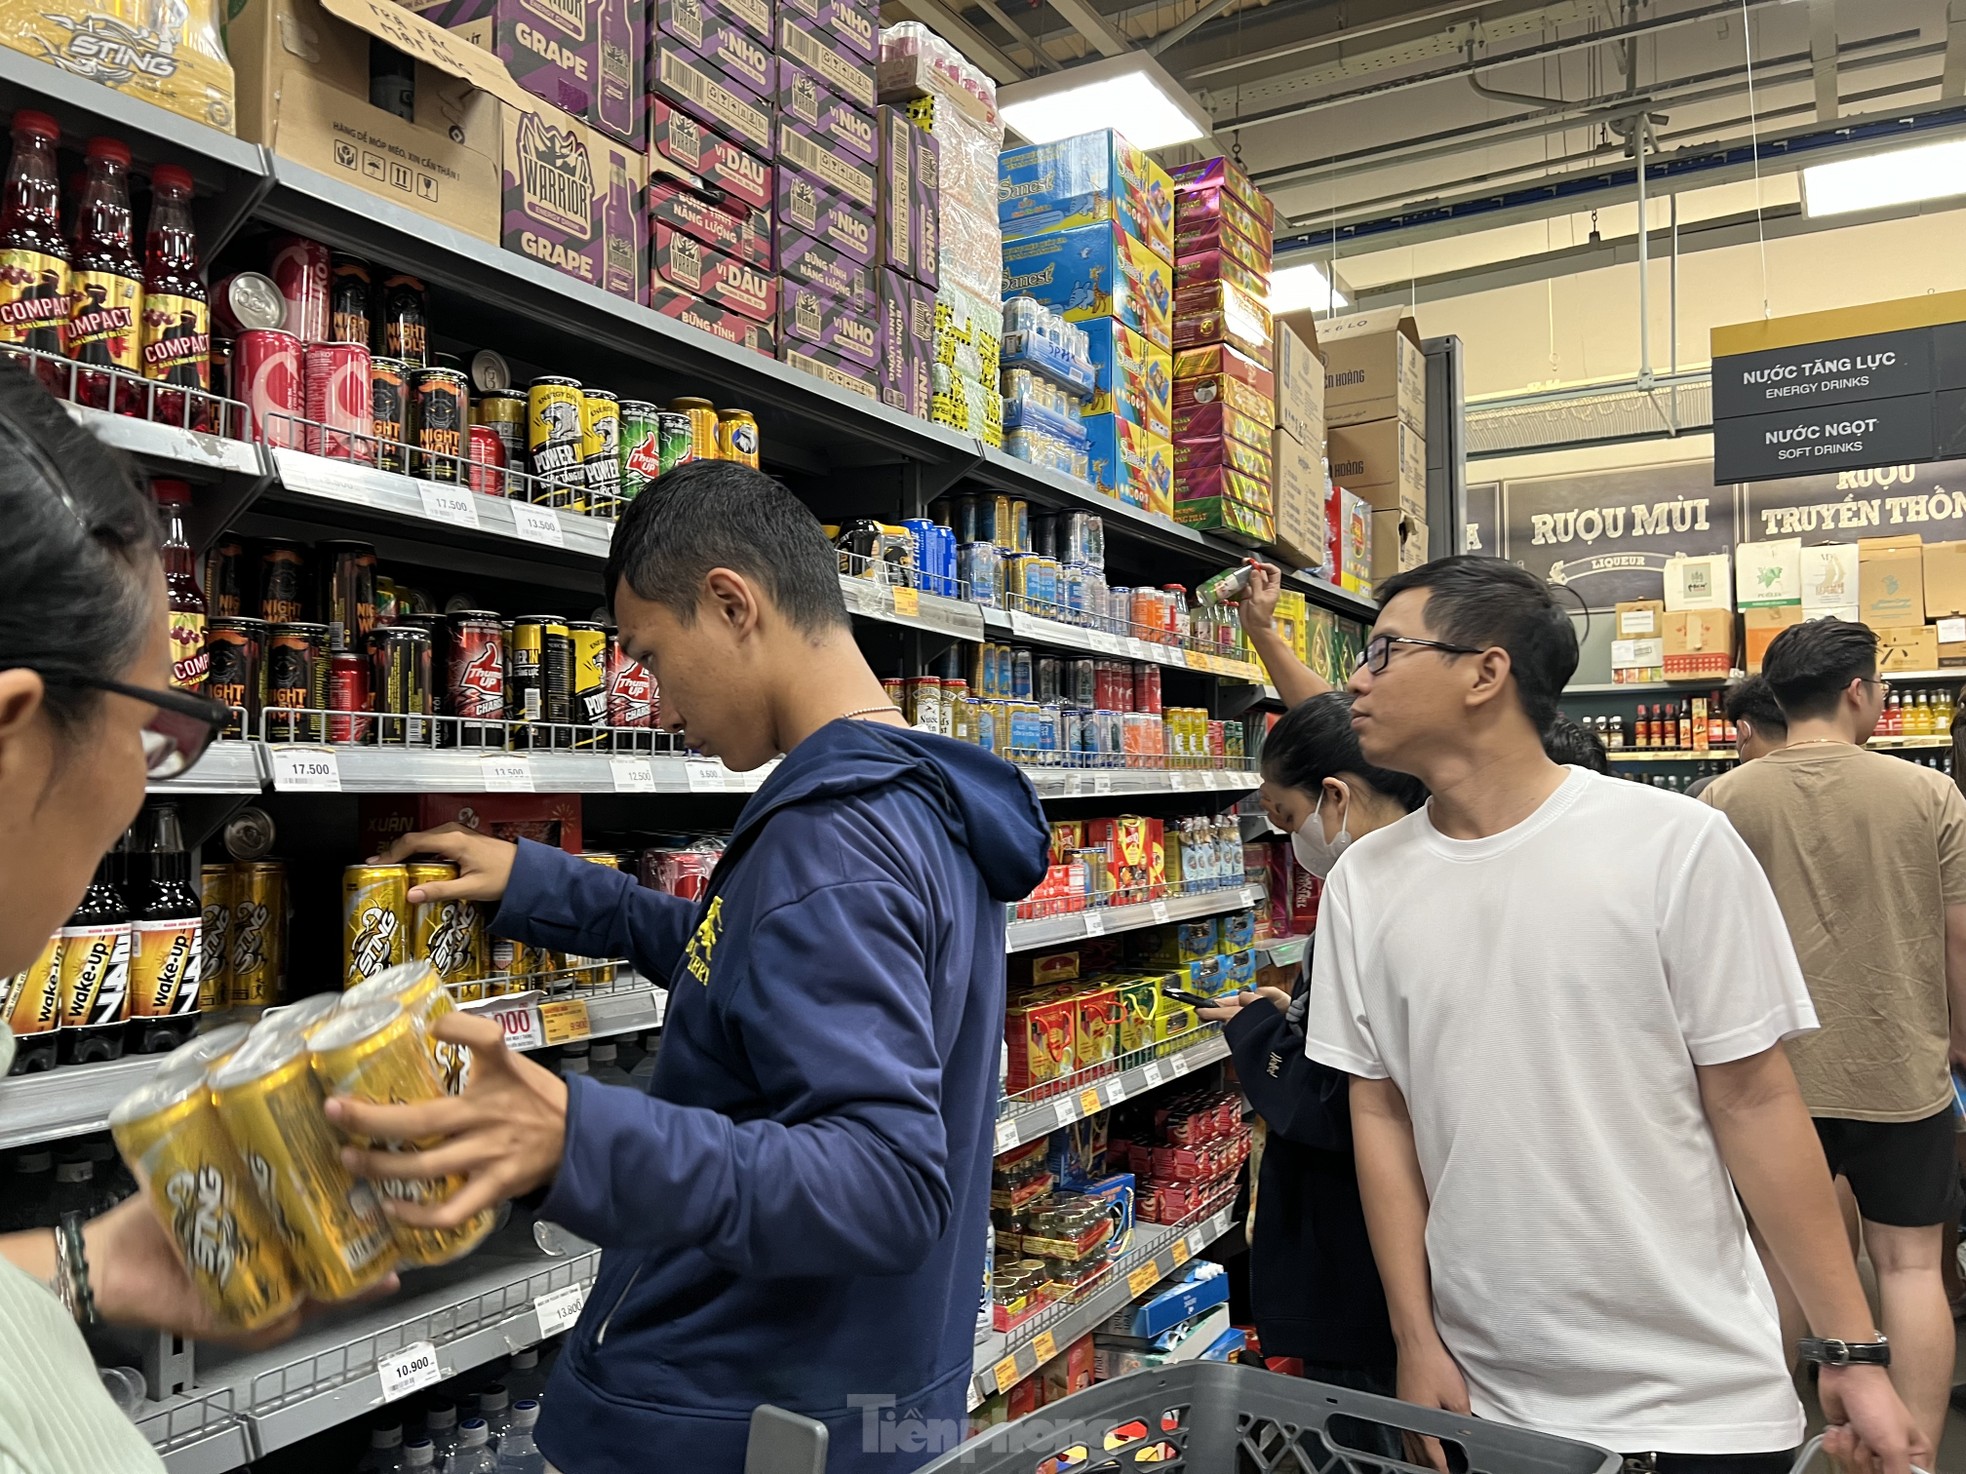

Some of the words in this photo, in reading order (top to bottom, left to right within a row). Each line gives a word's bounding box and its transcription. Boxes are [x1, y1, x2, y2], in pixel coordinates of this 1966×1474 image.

[841, 3, 872, 39] NHO
[69, 34, 176, 77] STING
[515, 22, 588, 81] GRAPE
[728, 32, 766, 72] NHO
[839, 108, 872, 141] NHO
[726, 150, 764, 185] DÂU
[523, 156, 589, 224] WARRIOR
[837, 211, 869, 242] NHO
[521, 232, 593, 279] GRAPE
[728, 266, 767, 299] DÂU
[387, 323, 426, 337] NIGHT
[681, 311, 711, 332] BỪNG
[843, 318, 874, 346] NHO
[145, 335, 209, 362] COMPACT
[388, 337, 425, 353] WOLF
[1802, 358, 1851, 377] TĂNG
[1856, 352, 1897, 373] LỰC
[1336, 369, 1365, 388] HOÀNG
[1766, 383, 1818, 399] ENERGY
[1821, 376, 1870, 392] DRINKS
[420, 428, 460, 443] NIGHT
[1765, 424, 1820, 445] NƯỚC
[1825, 418, 1877, 438] NGỌT
[533, 445, 574, 474] POWER
[1778, 447, 1812, 460] SOFT
[1814, 441, 1863, 456] DRINKS
[437, 498, 467, 512] 17.500
[528, 518, 556, 532] 13.500
[1531, 507, 1626, 545] RƯỢU
[1631, 495, 1710, 536] MÙI
[1592, 556, 1645, 569] LIQUEUR
[480, 675, 496, 688] UP
[292, 764, 330, 775] 17.500
[628, 772, 651, 782] 12.500
[358, 909, 397, 978] STING
[434, 904, 476, 969] STING
[396, 1356, 429, 1379] 10.900
